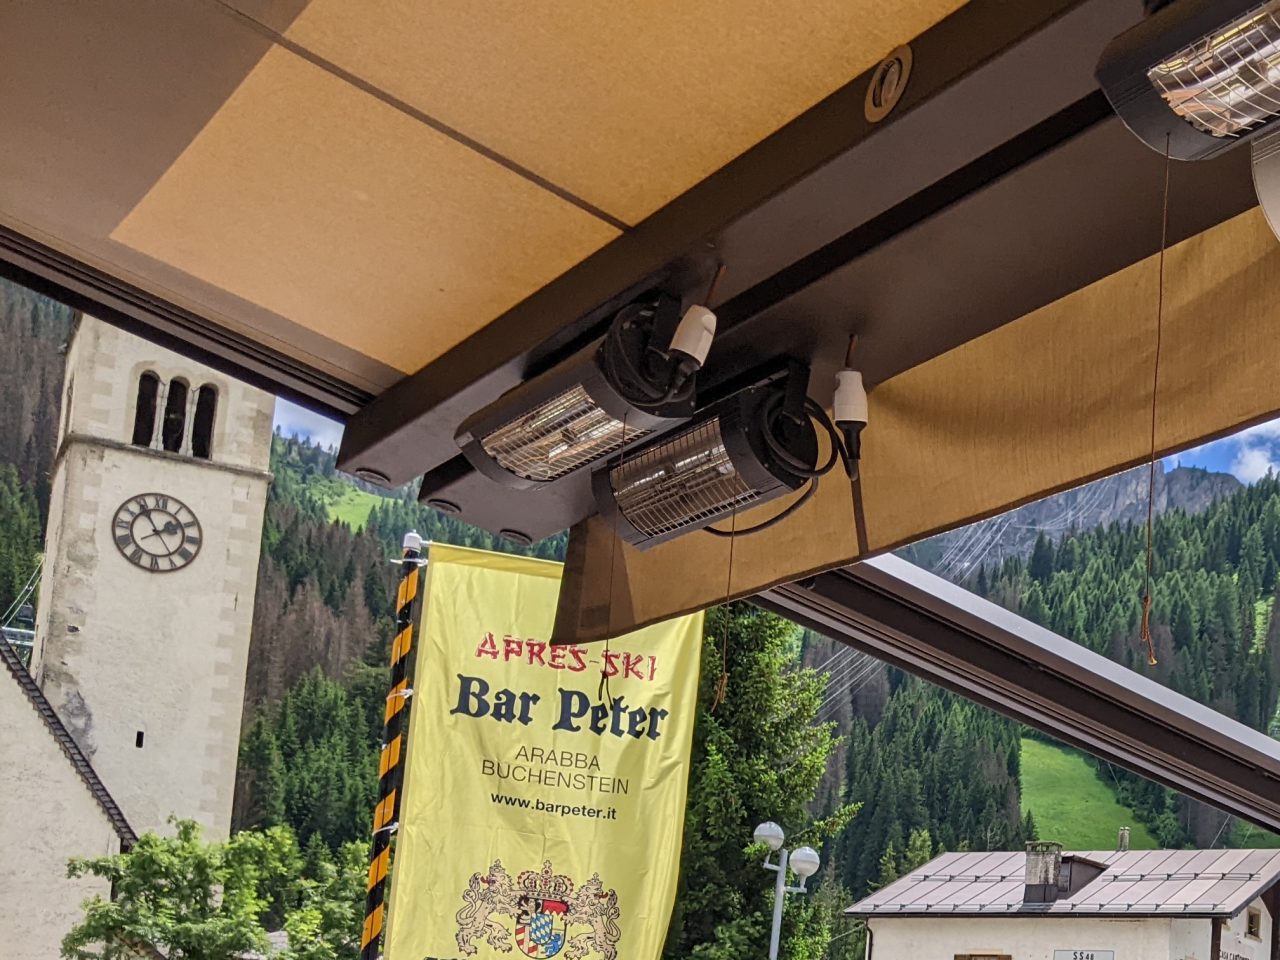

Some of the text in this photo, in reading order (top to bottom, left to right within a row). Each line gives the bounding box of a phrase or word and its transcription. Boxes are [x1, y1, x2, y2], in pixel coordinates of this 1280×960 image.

[450, 673, 669, 741] Bar Peter
[514, 745, 601, 772] ARABBA
[481, 759, 629, 795] BUCHENSTEIN
[490, 792, 617, 820] www.barpeter.it
